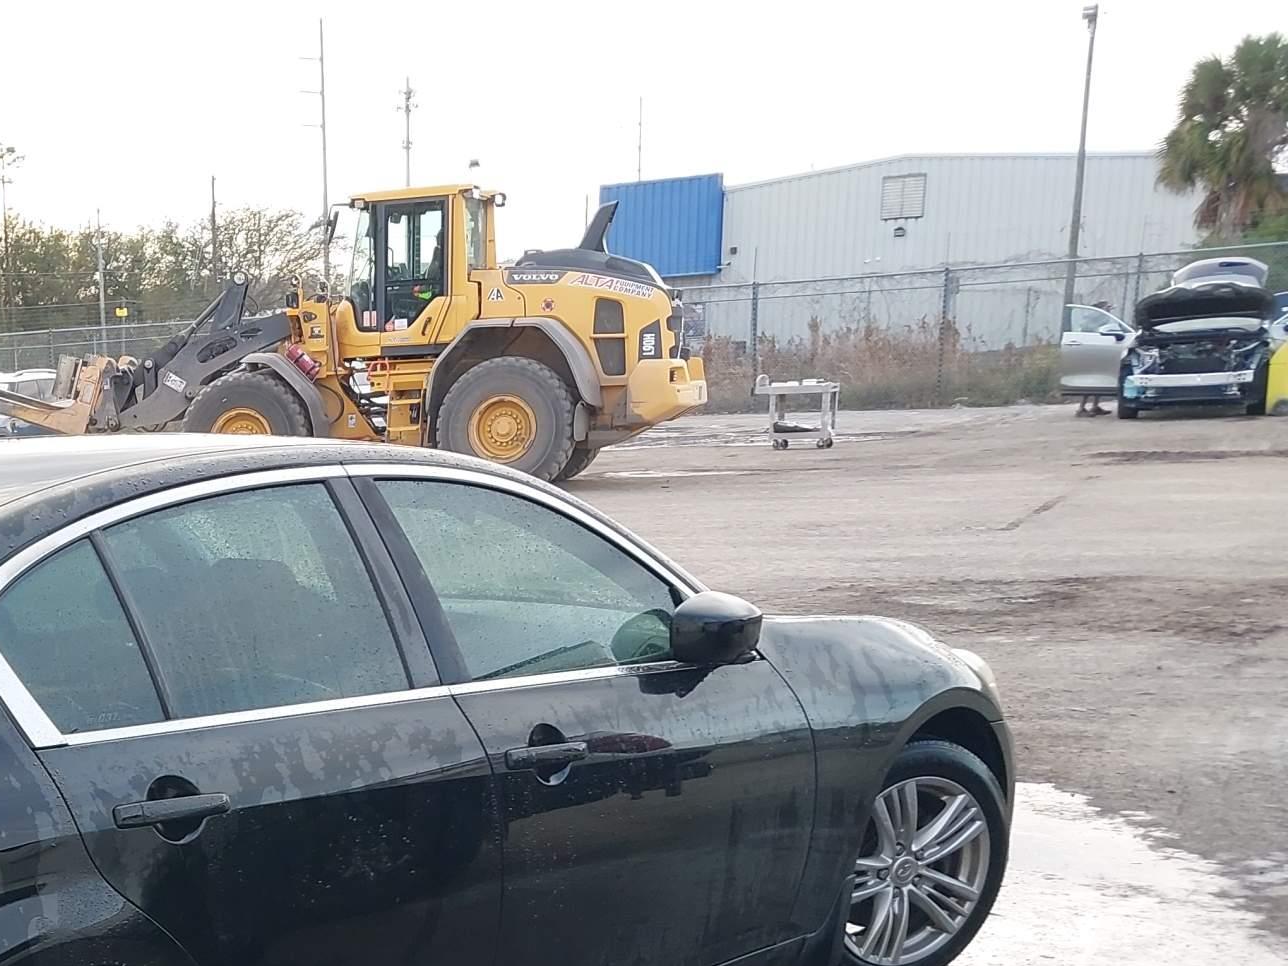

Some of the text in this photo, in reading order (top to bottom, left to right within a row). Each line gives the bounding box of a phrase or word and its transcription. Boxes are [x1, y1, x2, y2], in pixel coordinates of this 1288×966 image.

[570, 274, 615, 290] ALTA
[614, 279, 655, 293] EQUIPMENT
[613, 286, 652, 298] COMPANY
[642, 333, 656, 356] L90H
